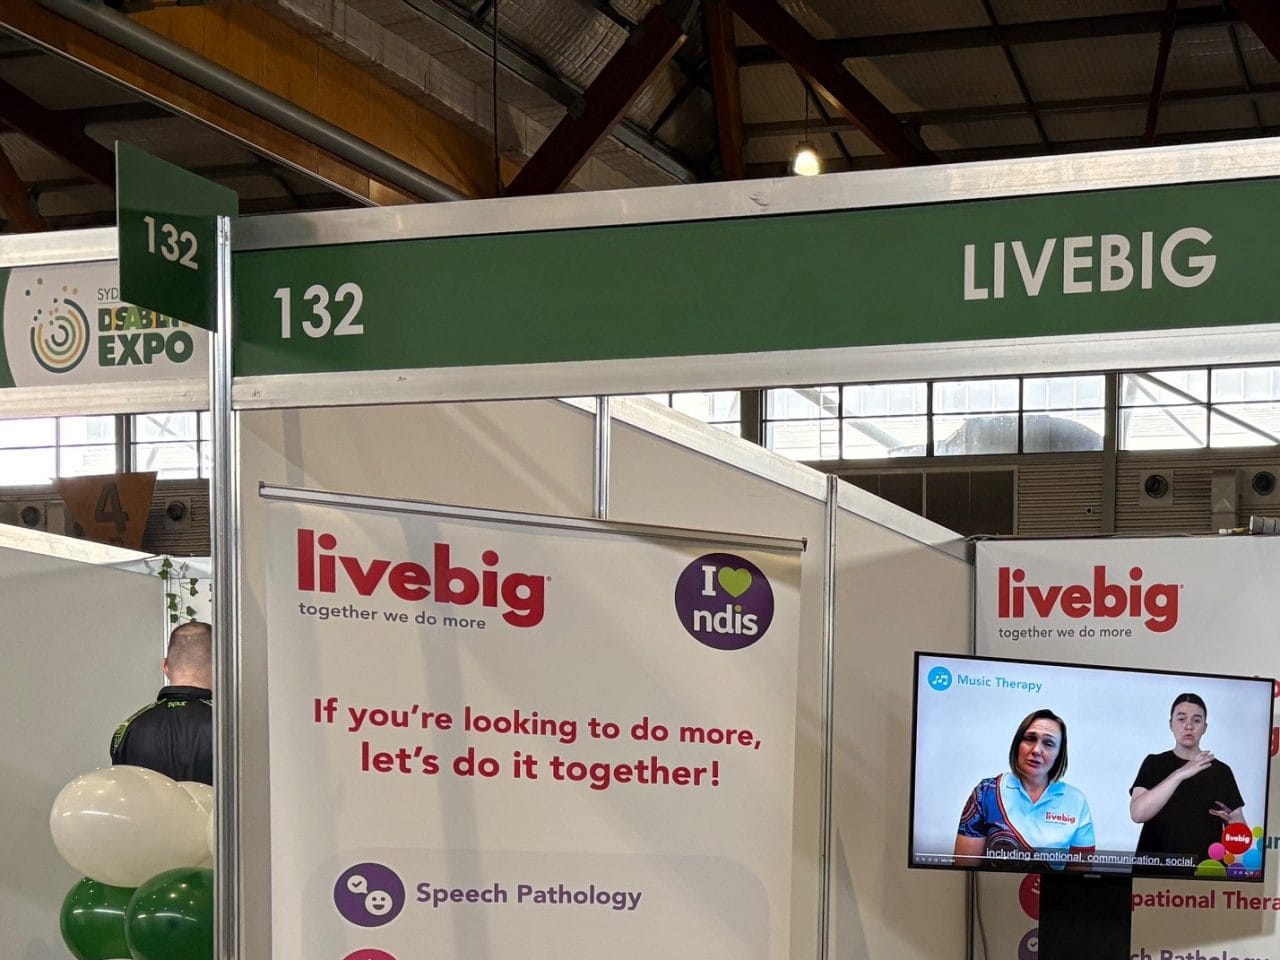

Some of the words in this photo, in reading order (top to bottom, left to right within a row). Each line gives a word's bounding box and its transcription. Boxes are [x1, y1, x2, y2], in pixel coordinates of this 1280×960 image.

[144, 216, 198, 269] 132
[964, 227, 1217, 300] LIVEBIG
[273, 282, 364, 339] 132
[98, 330, 193, 366] EXPO
[96, 482, 129, 531] 4
[297, 529, 546, 628] livebig
[701, 564, 717, 598] I
[299, 602, 378, 623] together
[383, 612, 409, 625] we
[414, 610, 438, 626] do
[443, 614, 487, 630] more
[998, 565, 1179, 633] livebig
[693, 605, 760, 636] ndis
[998, 626, 1052, 641] together
[1056, 629, 1075, 638] we
[1079, 626, 1095, 638] do
[1099, 628, 1132, 638] more
[957, 674, 992, 688] Music
[995, 677, 1042, 693] Therapy
[313, 698, 338, 724] If
[464, 707, 578, 744] looking
[587, 716, 621, 740] to
[630, 716, 670, 743] do
[679, 726, 762, 751] more,
[452, 748, 500, 779] do
[513, 751, 538, 781] it
[549, 755, 720, 791] together!
[1045, 812, 1076, 824] livebig
[986, 848, 1031, 860] including
[1225, 833, 1250, 844] livebig
[416, 883, 508, 909] Speech
[517, 884, 642, 912] Pathology
